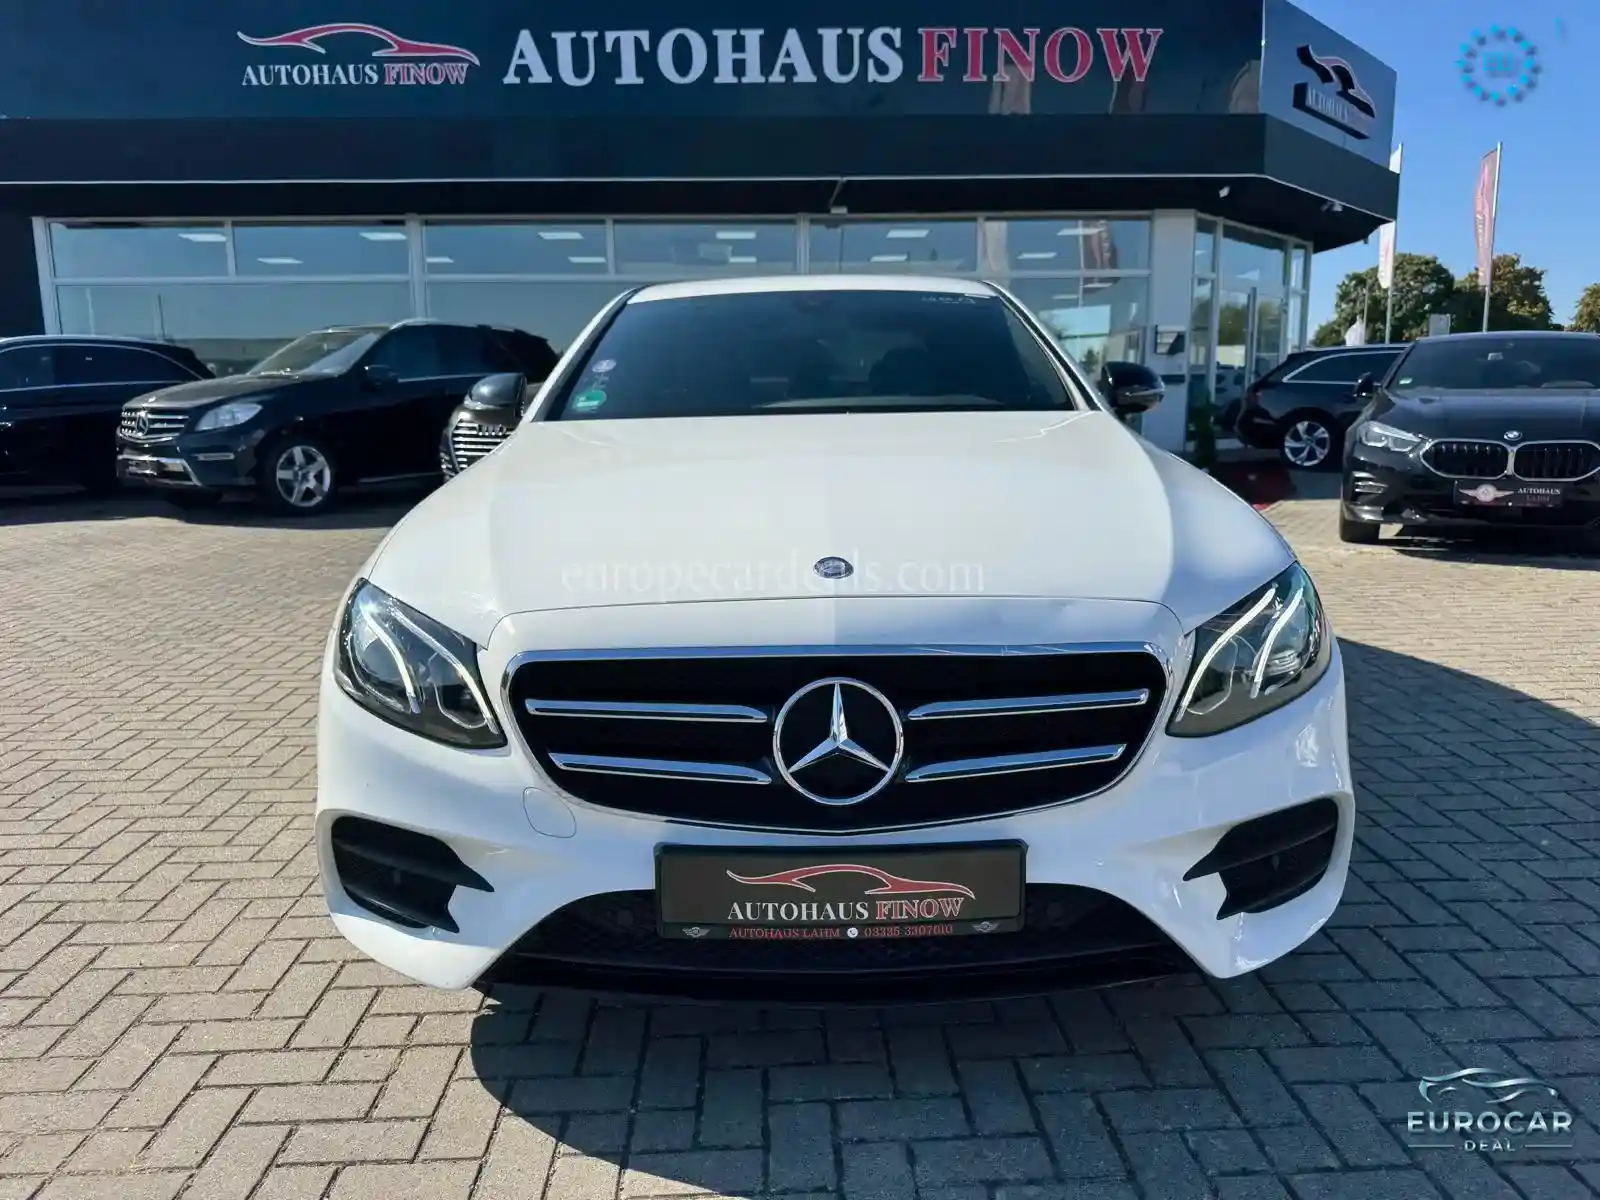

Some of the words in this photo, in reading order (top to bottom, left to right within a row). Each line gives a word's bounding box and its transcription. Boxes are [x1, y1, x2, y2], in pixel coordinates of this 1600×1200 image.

[502, 27, 903, 86] AUTOHAUS
[917, 26, 1164, 83] FINOW
[241, 63, 378, 86] AUTOHAUS
[383, 62, 469, 86] FINOW
[1518, 487, 1561, 495] AUTOHAUS
[728, 901, 869, 922] AUTOHAUS
[875, 897, 964, 919] FINOW
[729, 926, 799, 938] AUTOHAUS
